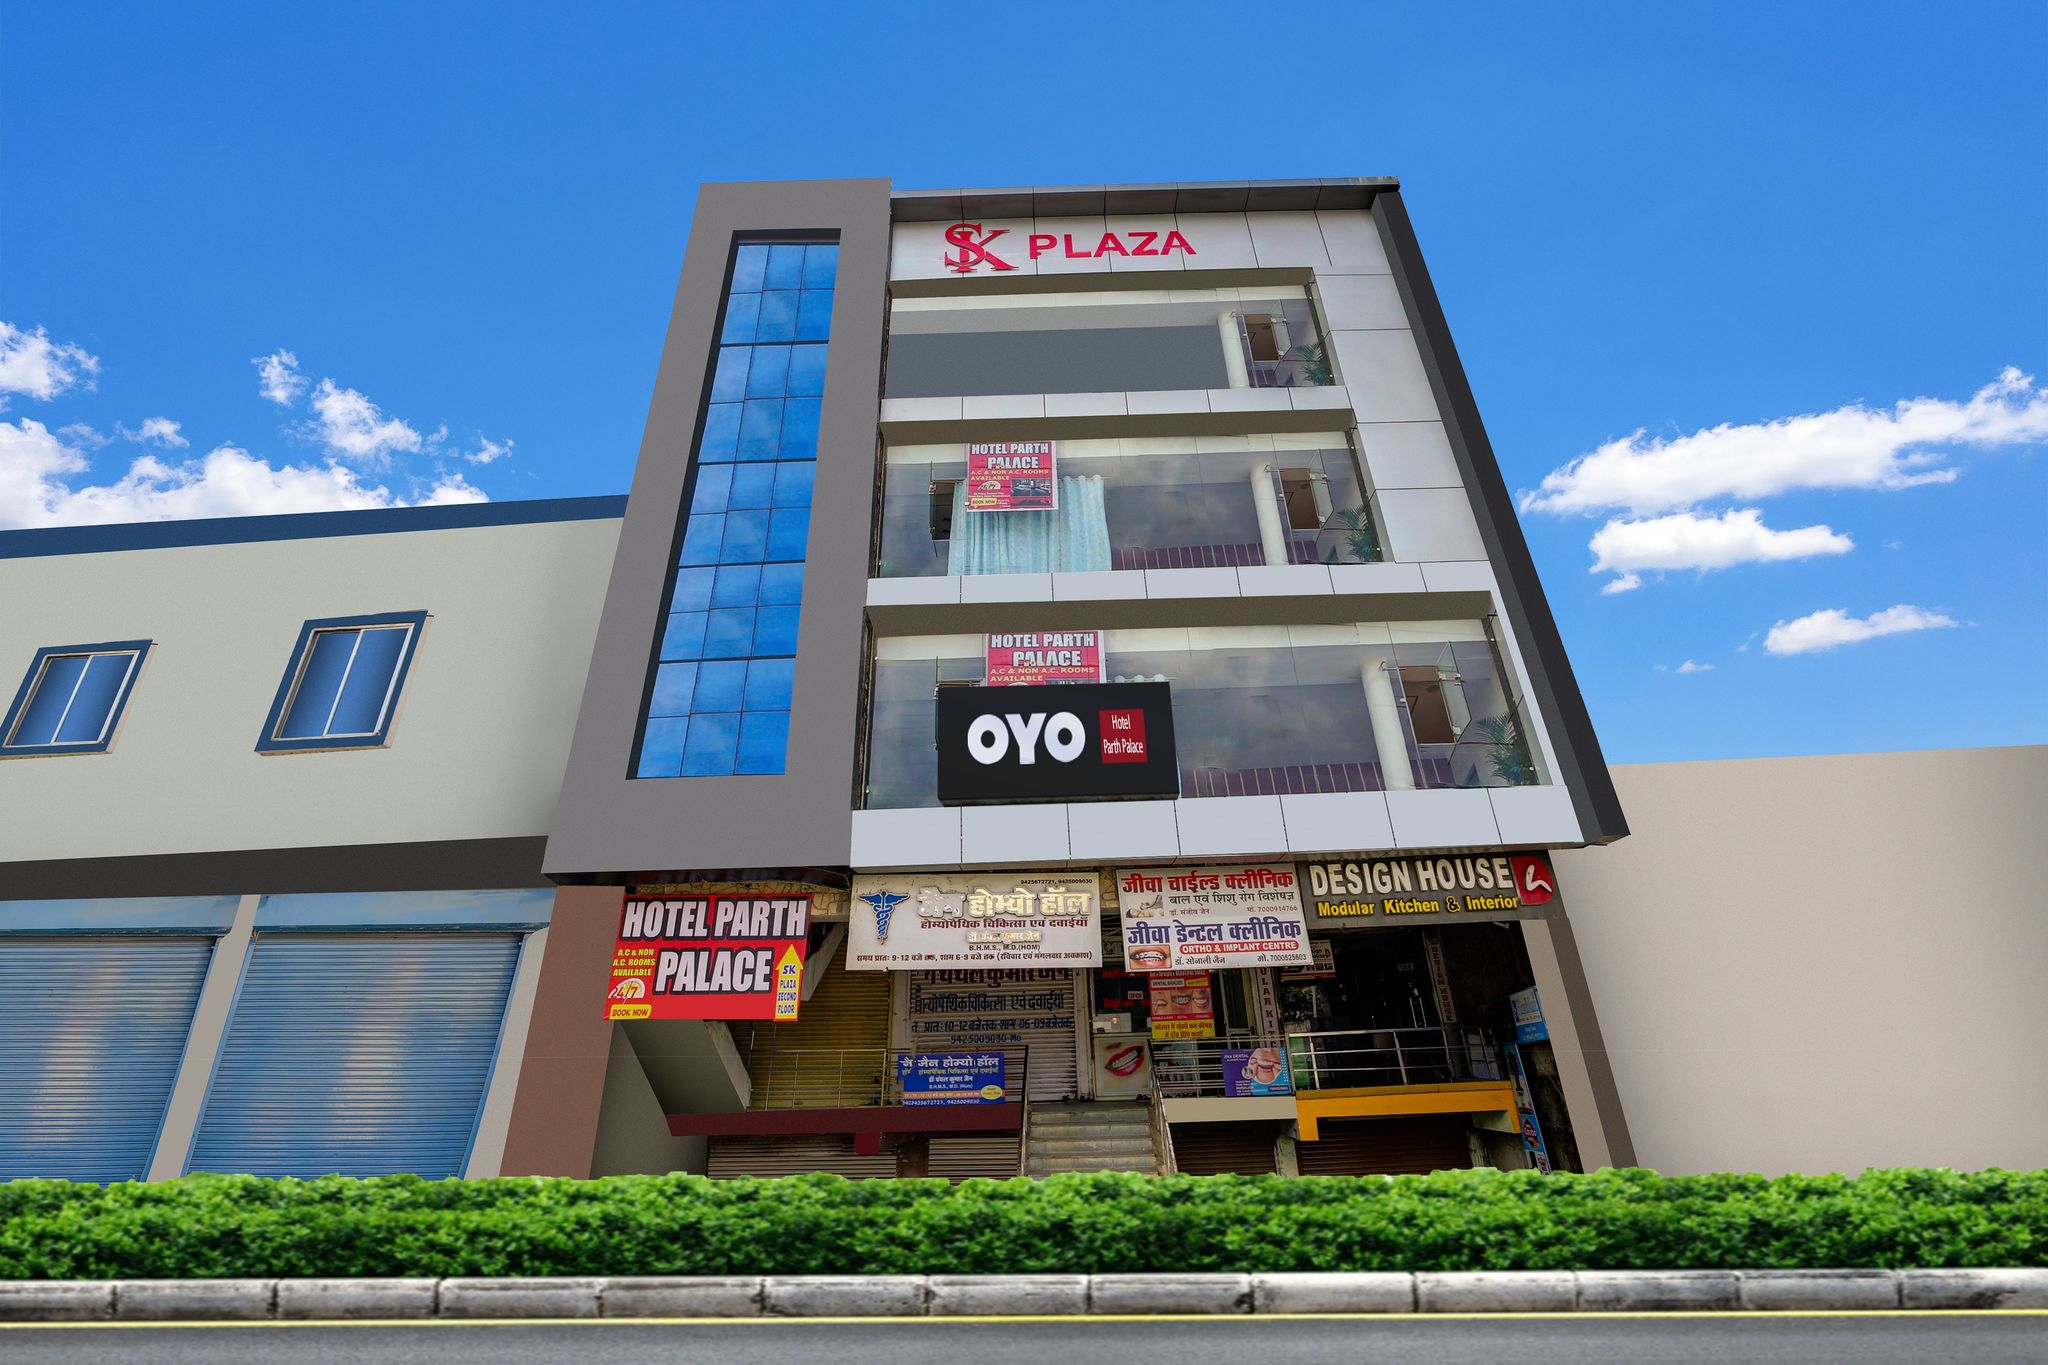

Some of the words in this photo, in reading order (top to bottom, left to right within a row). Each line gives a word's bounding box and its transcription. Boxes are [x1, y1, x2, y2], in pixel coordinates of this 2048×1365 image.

[944, 223, 1020, 272] SK
[1029, 230, 1197, 260] PLAZA
[972, 444, 1008, 454] HOTEL
[1010, 442, 1048, 454] PARTH
[988, 456, 1039, 469] PALACE
[991, 634, 1040, 648] HOTEL
[1043, 633, 1094, 647] PARTH
[1013, 650, 1081, 667] PALACE
[1111, 714, 1131, 730] Hotel
[967, 711, 1086, 765] OYO
[1103, 737, 1122, 754] Parth
[1122, 738, 1144, 754] Palace
[1121, 873, 1163, 893] जीवा
[1167, 870, 1220, 893] चाईल्ड
[1224, 868, 1294, 889] क्लीनिक
[1309, 860, 1412, 896] DESIGN
[1416, 857, 1514, 891] HOUSE
[968, 887, 1036, 917] होम्यो
[1040, 886, 1091, 915] हॉल
[1168, 894, 1190, 905] बाल
[1194, 891, 1210, 907] एवं
[1212, 891, 1238, 906] शिशु
[1240, 890, 1255, 902] रोग
[1258, 890, 1295, 902] विशेषज्ञ
[1318, 901, 1376, 916] Modular
[1384, 898, 1440, 914] Kitchen
[1446, 896, 1461, 912] &
[1467, 894, 1518, 910] Interior
[621, 900, 709, 938] HOTEL
[713, 900, 808, 938] PARTH
[1180, 908, 1200, 916] संजीव
[1200, 908, 1210, 916] जैन
[1030, 916, 1046, 928] एवं
[1126, 920, 1171, 944] जीवा
[1173, 919, 1224, 944] डेन्टल
[1228, 916, 1301, 941] क्लीनिक
[638, 948, 654, 956] NON
[1182, 944, 1213, 954] ORTHO
[1214, 943, 1221, 952] &
[1223, 942, 1261, 952] IMPLANT
[1262, 941, 1296, 951] CENTRE
[628, 958, 656, 966] ROOMS
[856, 954, 873, 962] समय
[1034, 951, 1062, 959] मंगलवार
[1175, 954, 1184, 966] डॉ.
[1186, 954, 1211, 965] सोनाली
[1212, 955, 1226, 964] जैन
[1257, 952, 1269, 962] मो.
[613, 968, 652, 976] AVAILABLE
[655, 950, 773, 992] PALACE
[782, 964, 796, 974] SK
[780, 980, 796, 988] PLAZA
[778, 992, 796, 1002] SECOND
[1011, 991, 1026, 1010] एवं
[632, 1008, 648, 1016] NOW
[778, 1004, 794, 1014] FLOOR
[918, 1056, 940, 1067] जैन
[942, 1056, 974, 1066] होम्यो
[976, 1054, 1000, 1066] हॉल
